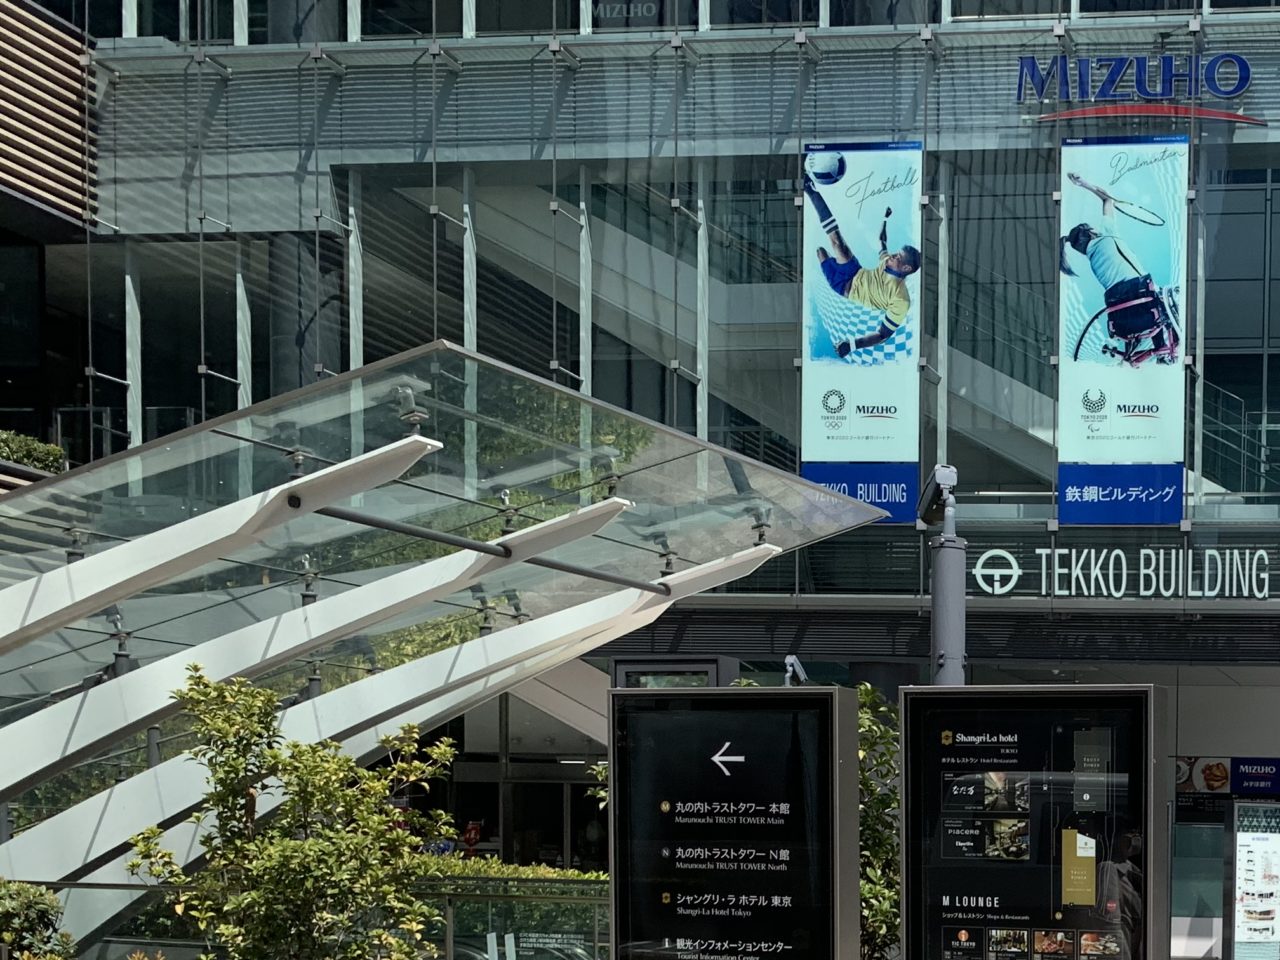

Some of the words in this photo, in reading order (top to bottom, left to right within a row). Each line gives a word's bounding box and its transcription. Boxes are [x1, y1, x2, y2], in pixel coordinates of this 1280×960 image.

[1016, 53, 1252, 101] MIZUHO
[844, 166, 920, 220] Football
[855, 405, 898, 415] MIZUHO
[1116, 404, 1160, 414] MIZUHO
[857, 482, 907, 503] BUILDING
[1035, 548, 1127, 598] TEKKO
[1139, 548, 1269, 599] BUILDING
[1239, 765, 1277, 774] MIZUHO
[675, 801, 766, 814] 丸の内トラストタワー
[768, 802, 790, 815] 本館
[674, 815, 714, 824] Marunouchi
[715, 816, 737, 824] TRUST
[739, 816, 766, 825] TOWER
[766, 817, 785, 825] Main
[675, 847, 766, 860] 丸の内トラストタワー
[675, 861, 715, 870] Marunouchi
[716, 861, 738, 870] TRUST
[739, 862, 766, 871] TOWER
[767, 862, 788, 871] North
[738, 894, 769, 907] ホテル
[771, 895, 792, 908] 東京
[942, 895, 950, 906] M
[955, 895, 1000, 908] LOUNGE
[676, 907, 711, 917] Shangri-La
[711, 908, 730, 916] Hotel
[731, 908, 752, 918] Tokyo
[676, 938, 793, 953] 観光インフォメーションセンター
[677, 952, 699, 960] Tourist
[699, 953, 737, 960] Information
